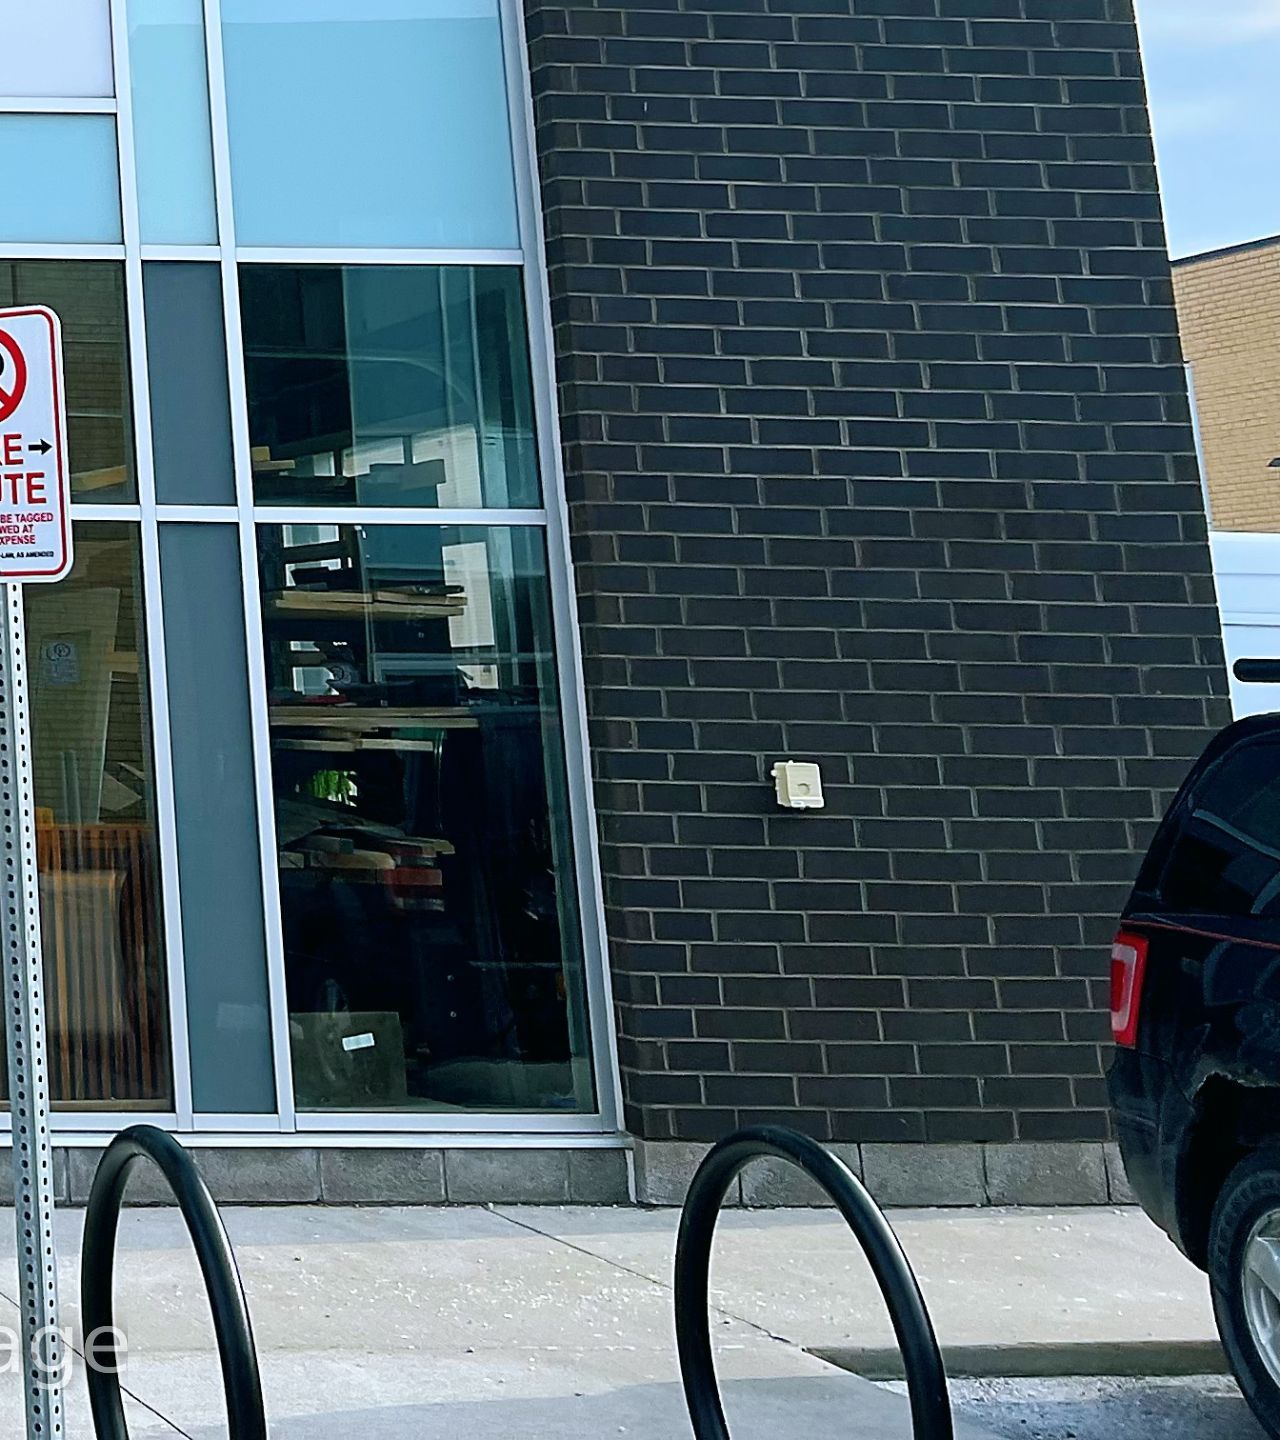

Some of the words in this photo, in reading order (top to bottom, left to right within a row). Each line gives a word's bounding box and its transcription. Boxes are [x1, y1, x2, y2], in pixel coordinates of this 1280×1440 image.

[0, 514, 13, 523] BE
[15, 513, 53, 522] TAGGED
[22, 524, 33, 533] AT
